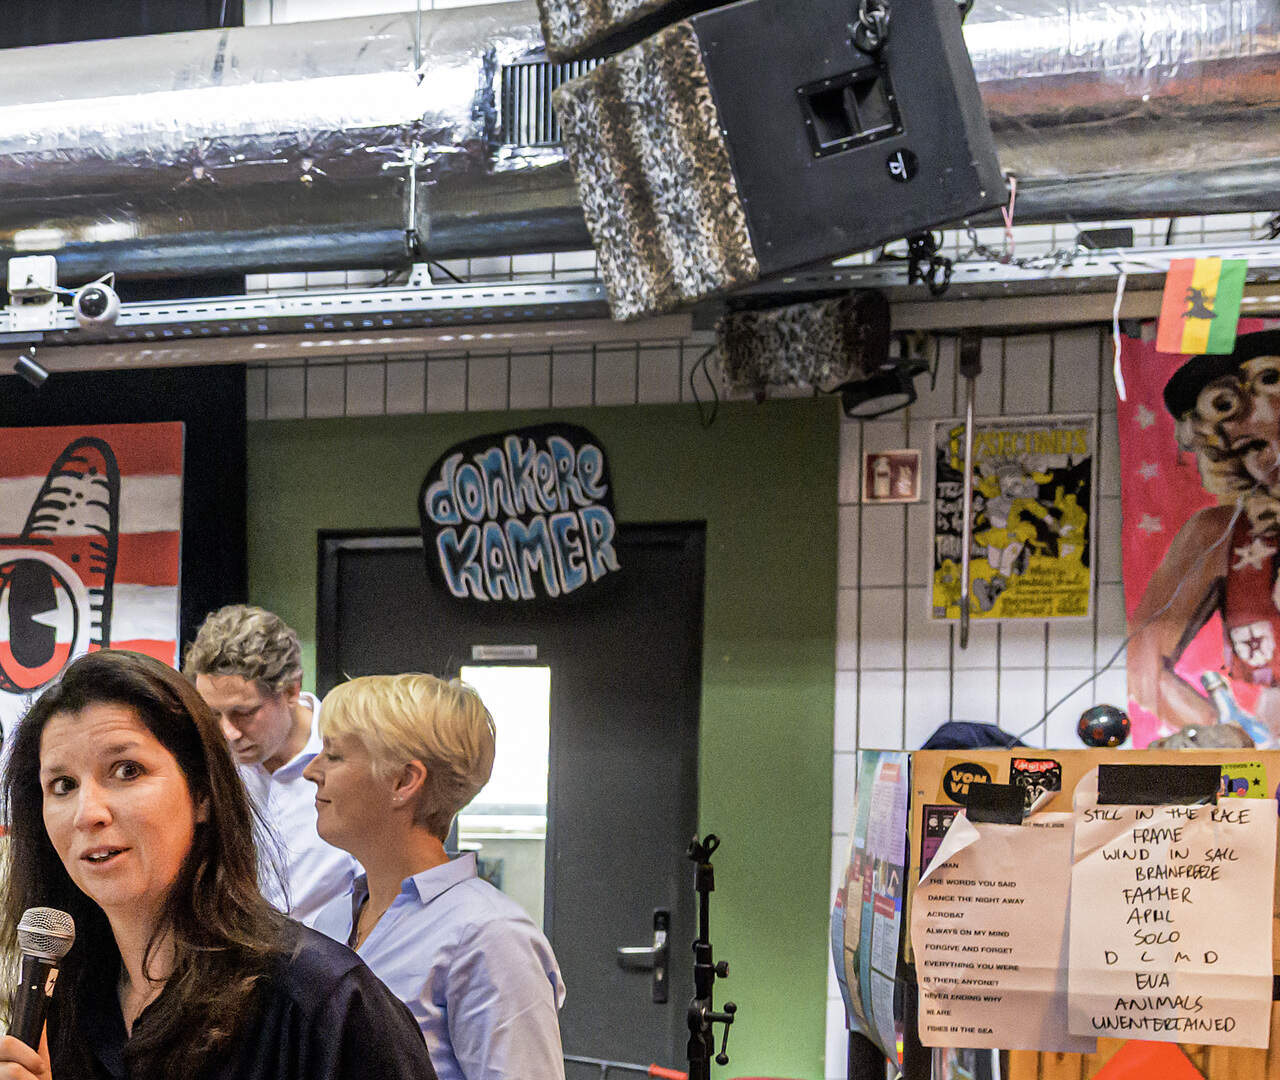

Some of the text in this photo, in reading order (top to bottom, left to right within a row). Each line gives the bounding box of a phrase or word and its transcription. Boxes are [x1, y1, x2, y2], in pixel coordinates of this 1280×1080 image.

[436, 504, 622, 601] KAMER
[1083, 807, 1252, 824] STILL IN THE RACE
[1132, 826, 1185, 845] FRAME
[1102, 848, 1150, 861] WIND
[1169, 848, 1190, 860] IN
[1135, 865, 1222, 882] BRAINFREEZE
[1122, 886, 1194, 905] FATHER
[1133, 929, 1182, 947] SOLO
[925, 944, 959, 952] FORGIVE
[981, 946, 1013, 954] FORGET
[1104, 950, 1119, 965] D
[1203, 950, 1219, 965] D
[924, 961, 975, 969] EVERYTHING
[934, 977, 959, 985] THERE
[1135, 971, 1170, 990] EVA
[1114, 995, 1204, 1012] ANIMALS
[1091, 1015, 1237, 1033] UNENTERTAINED
